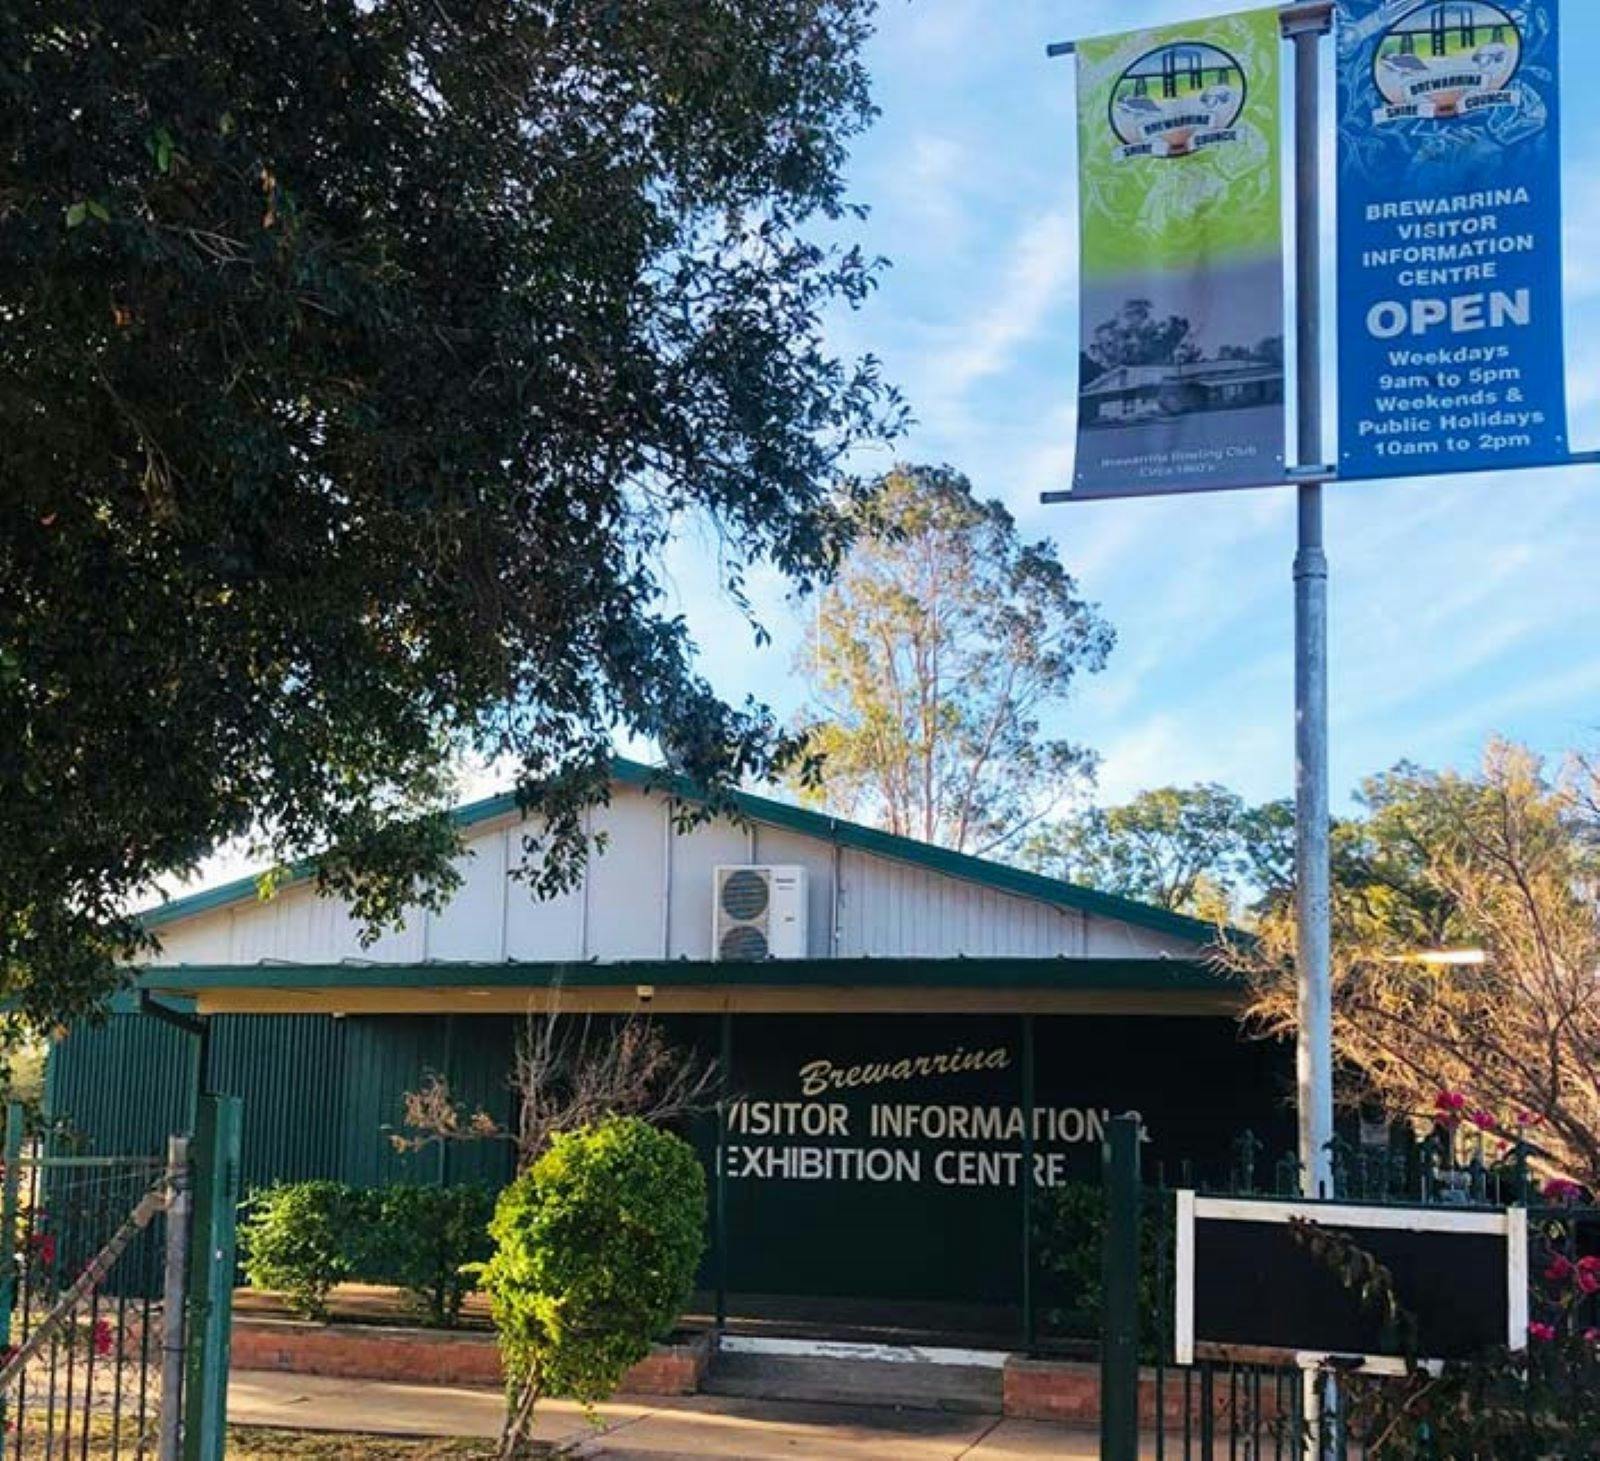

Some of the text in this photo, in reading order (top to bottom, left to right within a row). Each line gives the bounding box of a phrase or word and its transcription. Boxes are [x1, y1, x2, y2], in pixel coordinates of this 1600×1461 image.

[1365, 187, 1530, 220] BREWARRINA
[1397, 214, 1498, 240] VISITOR
[1362, 235, 1535, 268] INFORMATION
[1398, 262, 1498, 286] CENTRE
[1366, 288, 1530, 338] OPEN
[1388, 344, 1509, 366] Weekdays
[1379, 367, 1520, 390] 9am to 5pm
[1375, 387, 1524, 411] Weekends &
[1359, 410, 1545, 436] Public Holidays
[1375, 434, 1530, 455] 10am to 2pm
[799, 1046, 1012, 1096] Brewarrina
[717, 1102, 850, 1137] VISITOR
[871, 1104, 1109, 1142] INFORMATION
[717, 1146, 1067, 1188] EXHIBITION CENTRE
